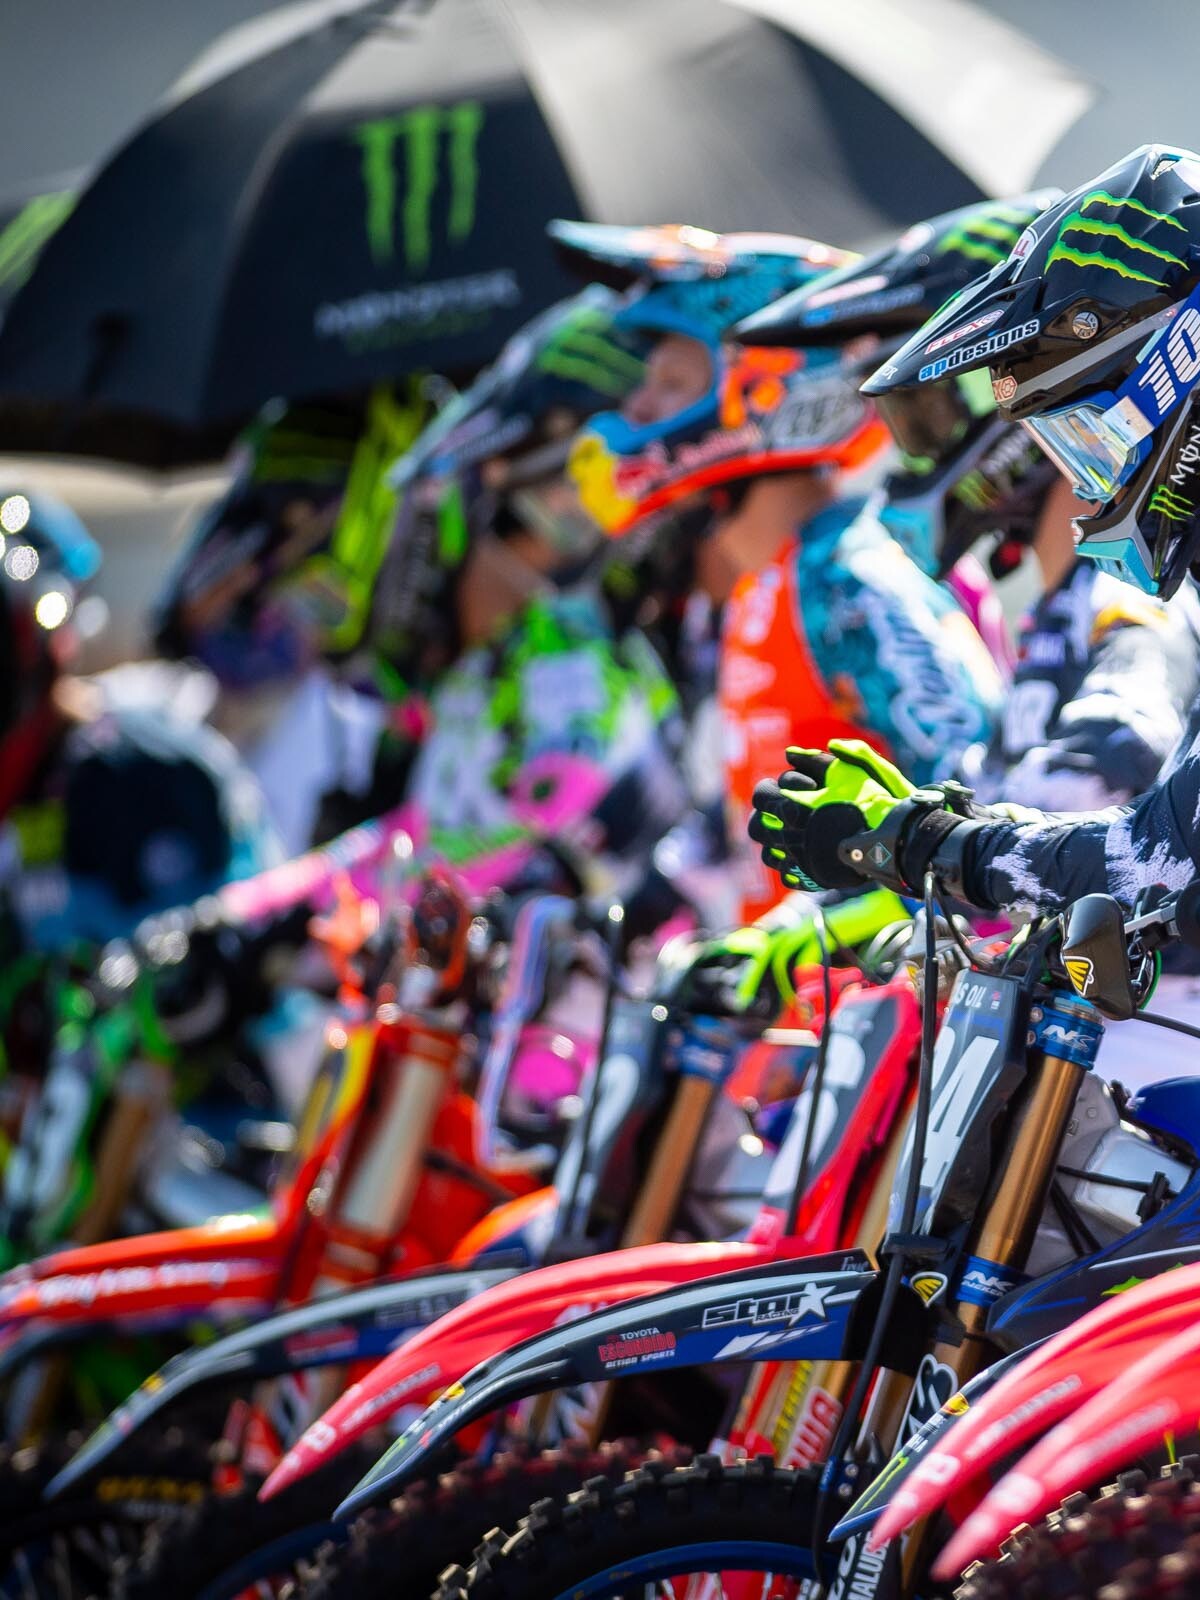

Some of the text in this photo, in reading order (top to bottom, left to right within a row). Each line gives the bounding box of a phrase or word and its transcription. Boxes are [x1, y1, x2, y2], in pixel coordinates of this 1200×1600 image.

[918, 319, 1040, 382] apdesigns
[756, 1308, 800, 1322] RACING
[620, 1327, 660, 1341] TOYOTA
[641, 1348, 676, 1362] SPORTS
